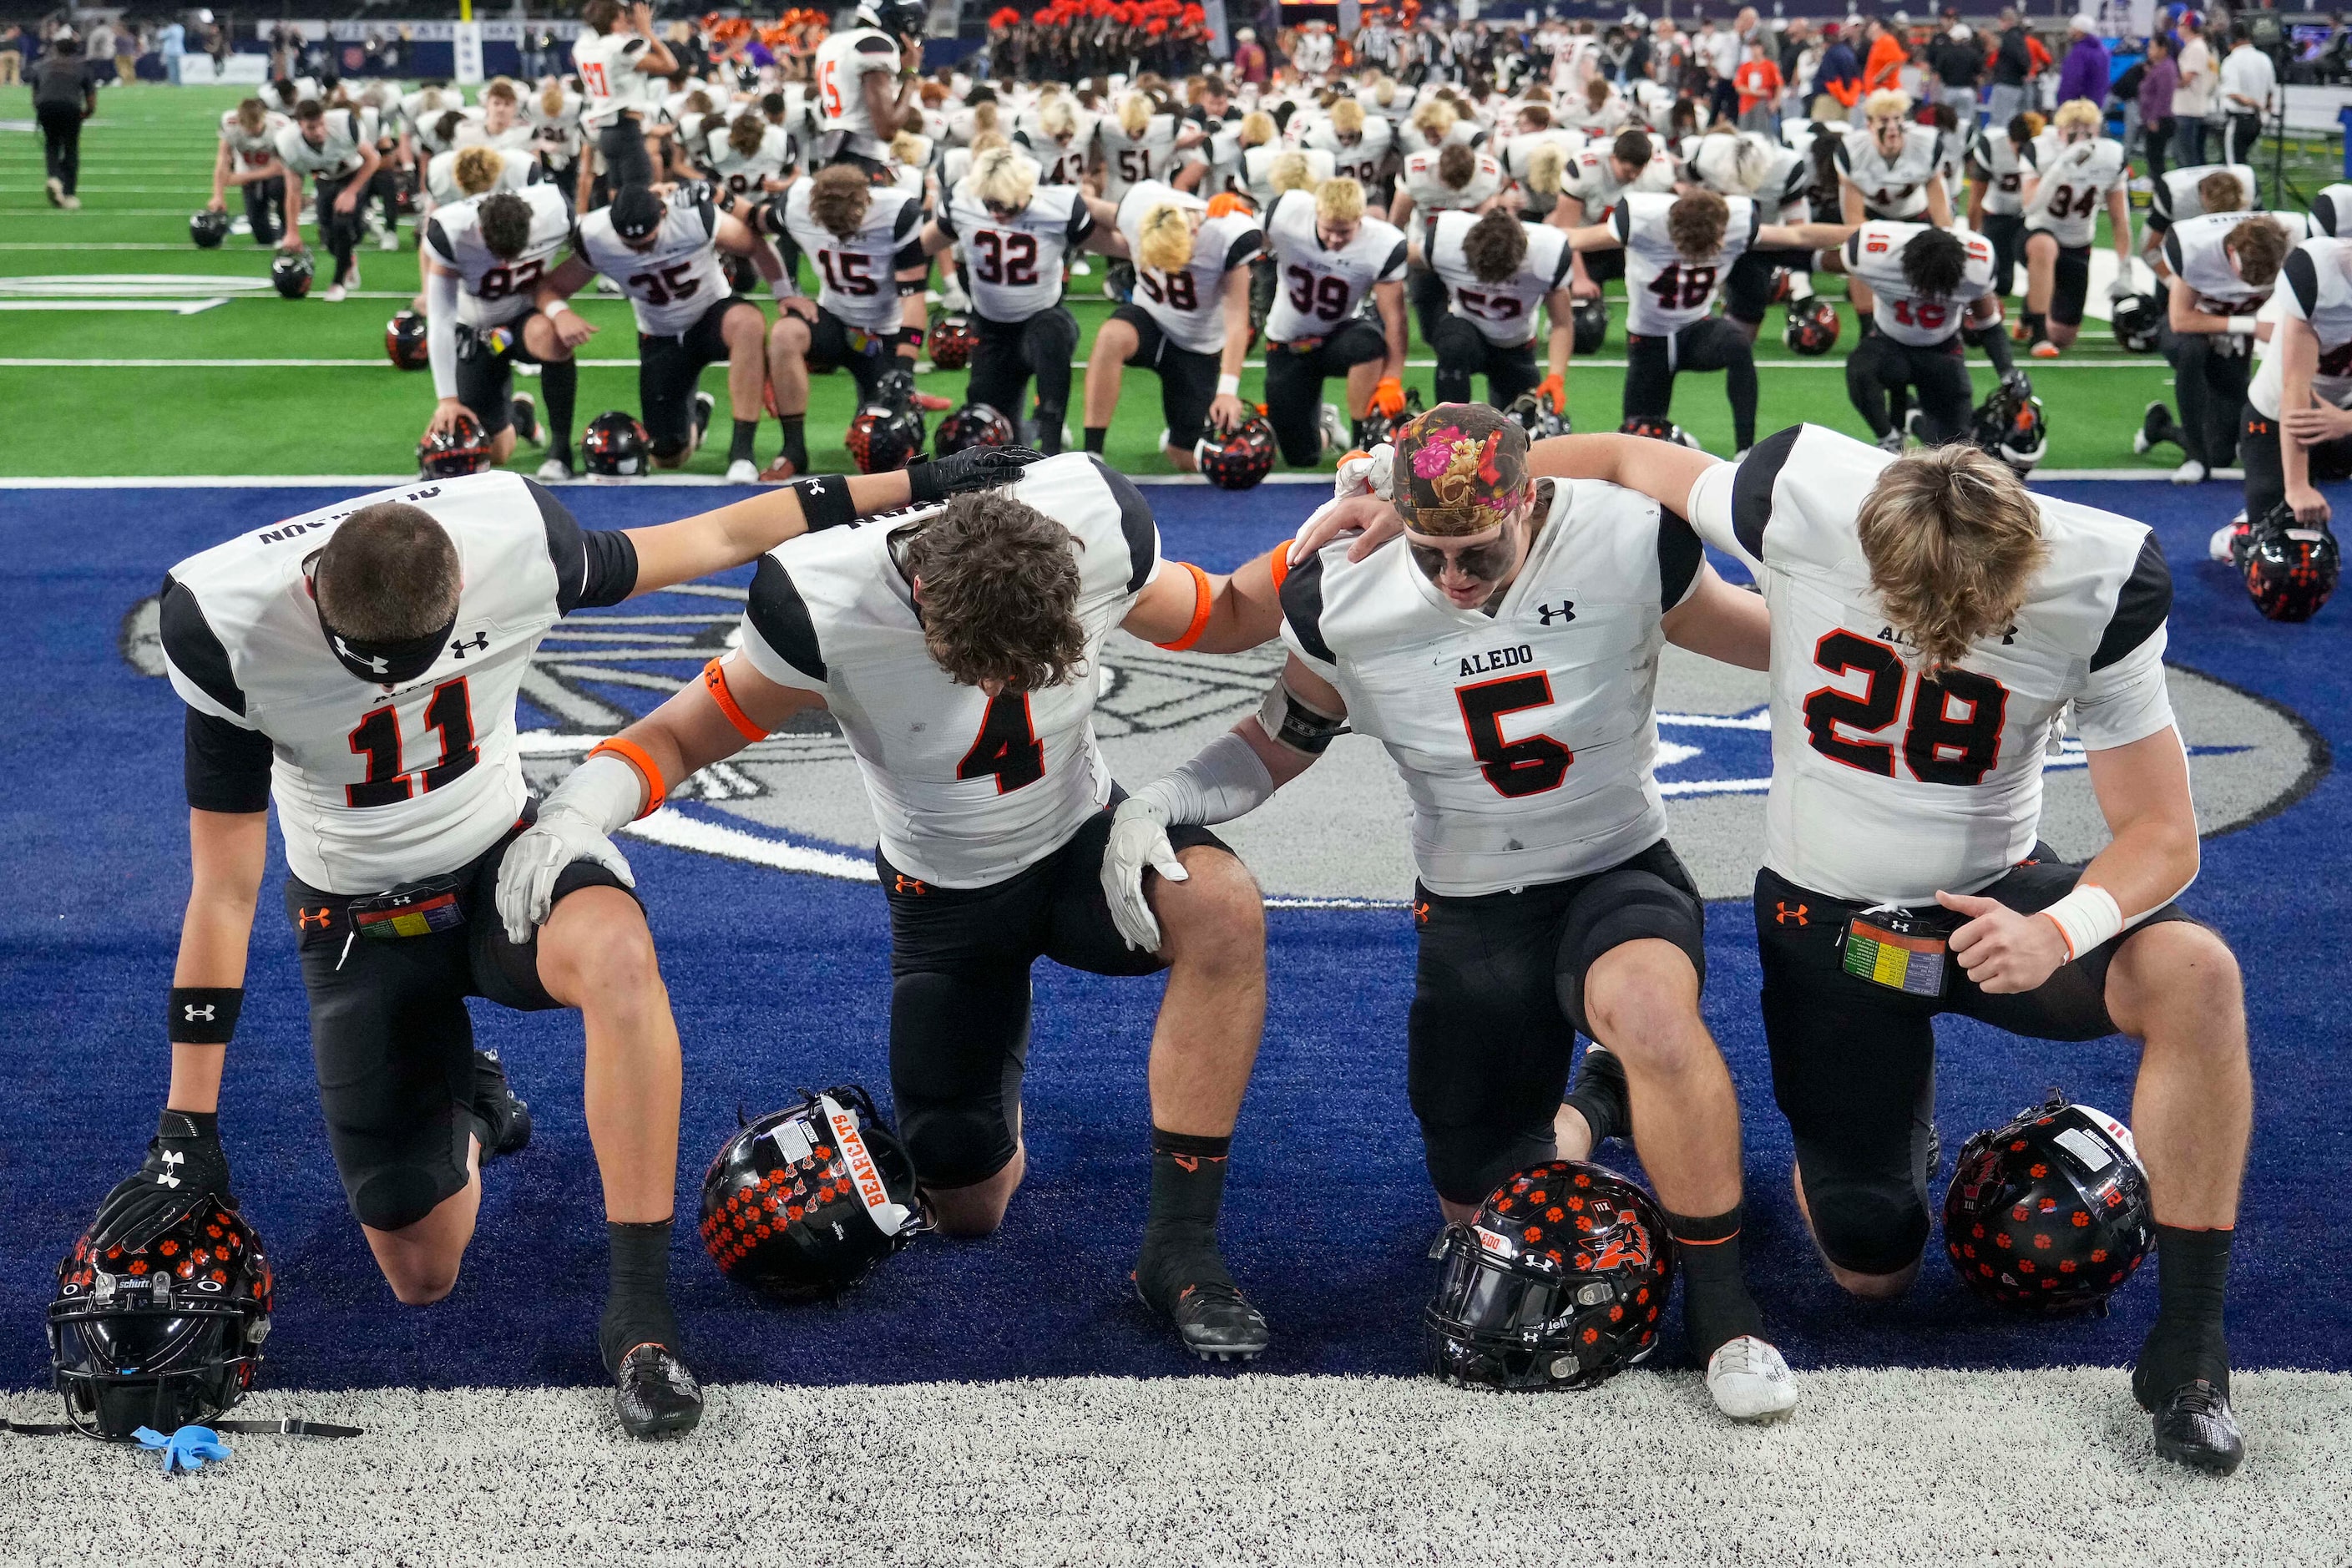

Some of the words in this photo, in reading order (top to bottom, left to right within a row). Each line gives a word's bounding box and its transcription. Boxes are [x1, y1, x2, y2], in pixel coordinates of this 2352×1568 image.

[1119, 149, 1152, 183] 51
[2047, 184, 2098, 220] 34
[629, 261, 701, 306] 35
[817, 249, 878, 296] 15
[974, 230, 1039, 287] 32
[1648, 260, 1717, 309] 48
[1287, 265, 1349, 321] 39
[119, 444, 151, 454] schutt
[1459, 645, 1533, 676] ALEDO
[1803, 627, 2011, 786] 28
[346, 675, 480, 807] 11
[956, 678, 1046, 796] 4
[1454, 670, 1574, 799] 5
[832, 1114, 887, 1208] BEARCATS
